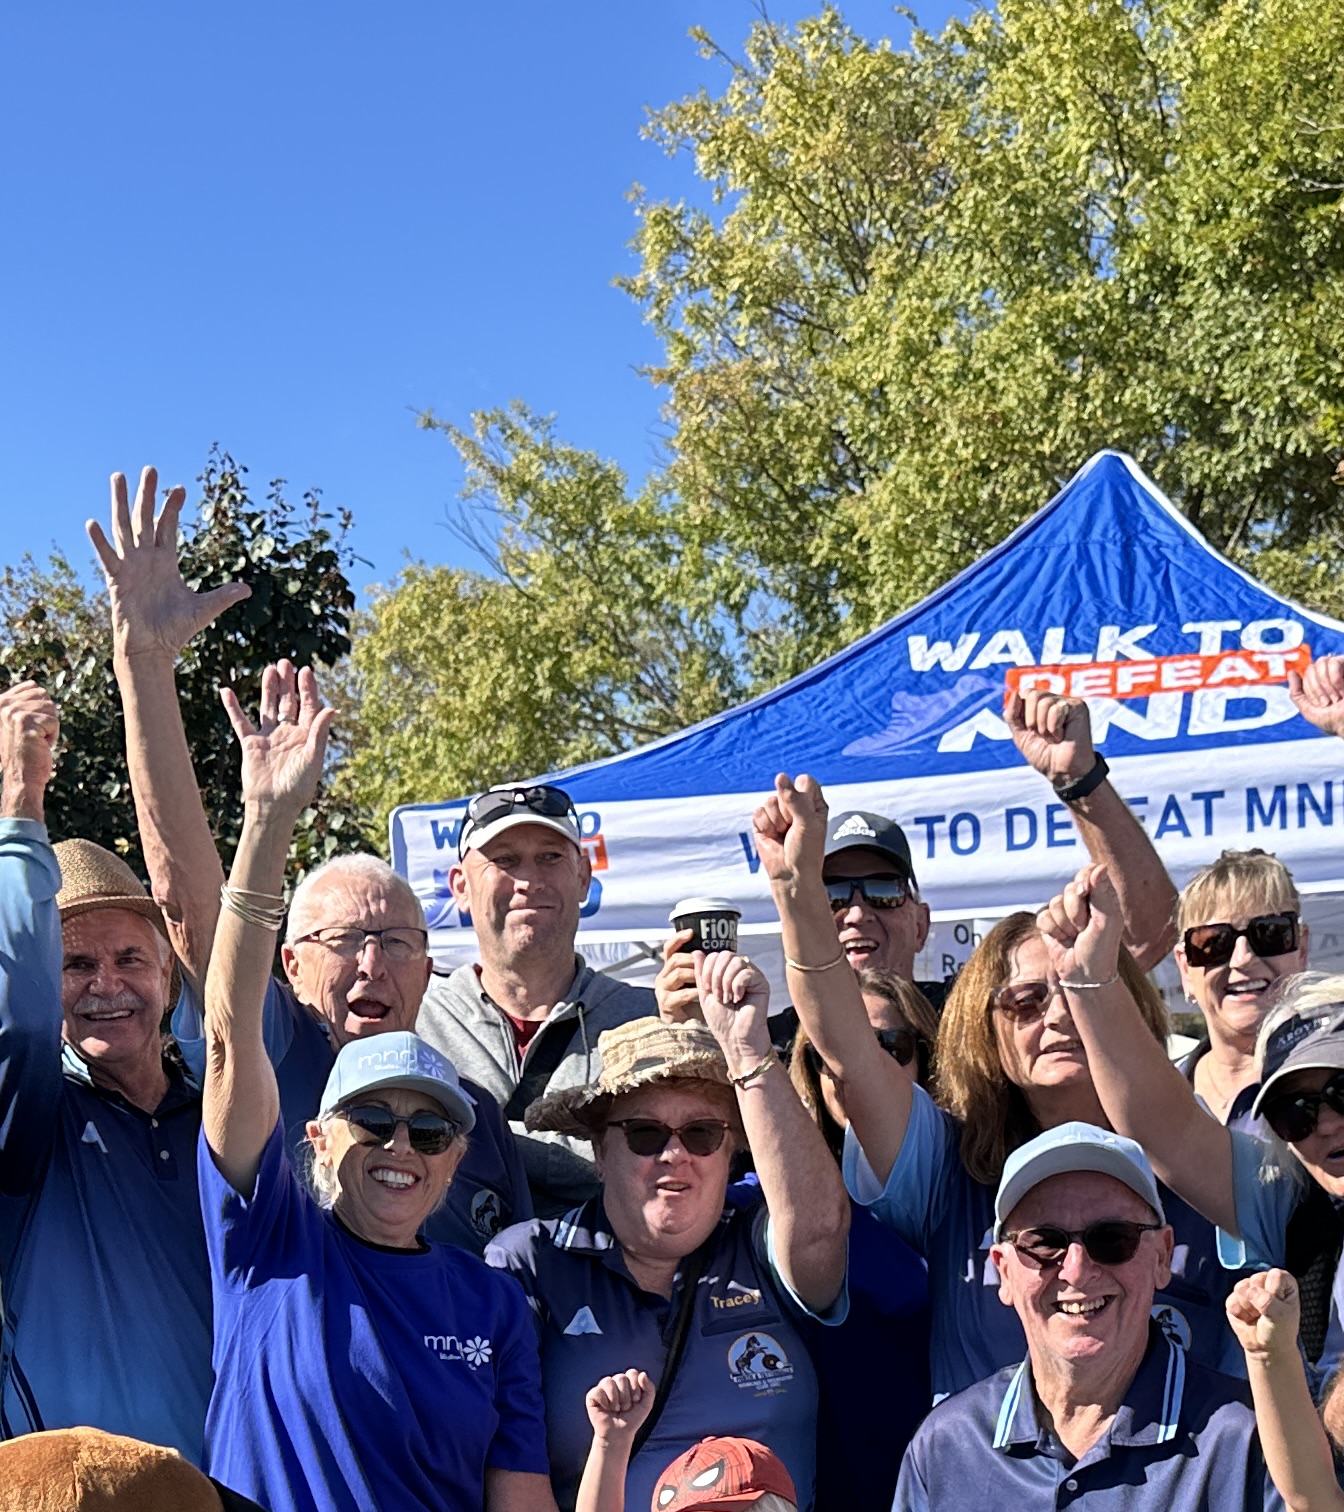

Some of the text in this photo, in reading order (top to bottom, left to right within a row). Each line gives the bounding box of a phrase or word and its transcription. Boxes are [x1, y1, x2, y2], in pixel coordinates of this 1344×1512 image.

[907, 618, 1304, 672] WALK TO
[1019, 652, 1300, 697] DEFEAT
[914, 812, 981, 858] TO
[1005, 790, 1225, 852] DEAT
[700, 918, 737, 940] FiOR
[702, 940, 738, 951] COFFE
[710, 1293, 760, 1309] Tracey
[424, 1335, 463, 1355] mn
